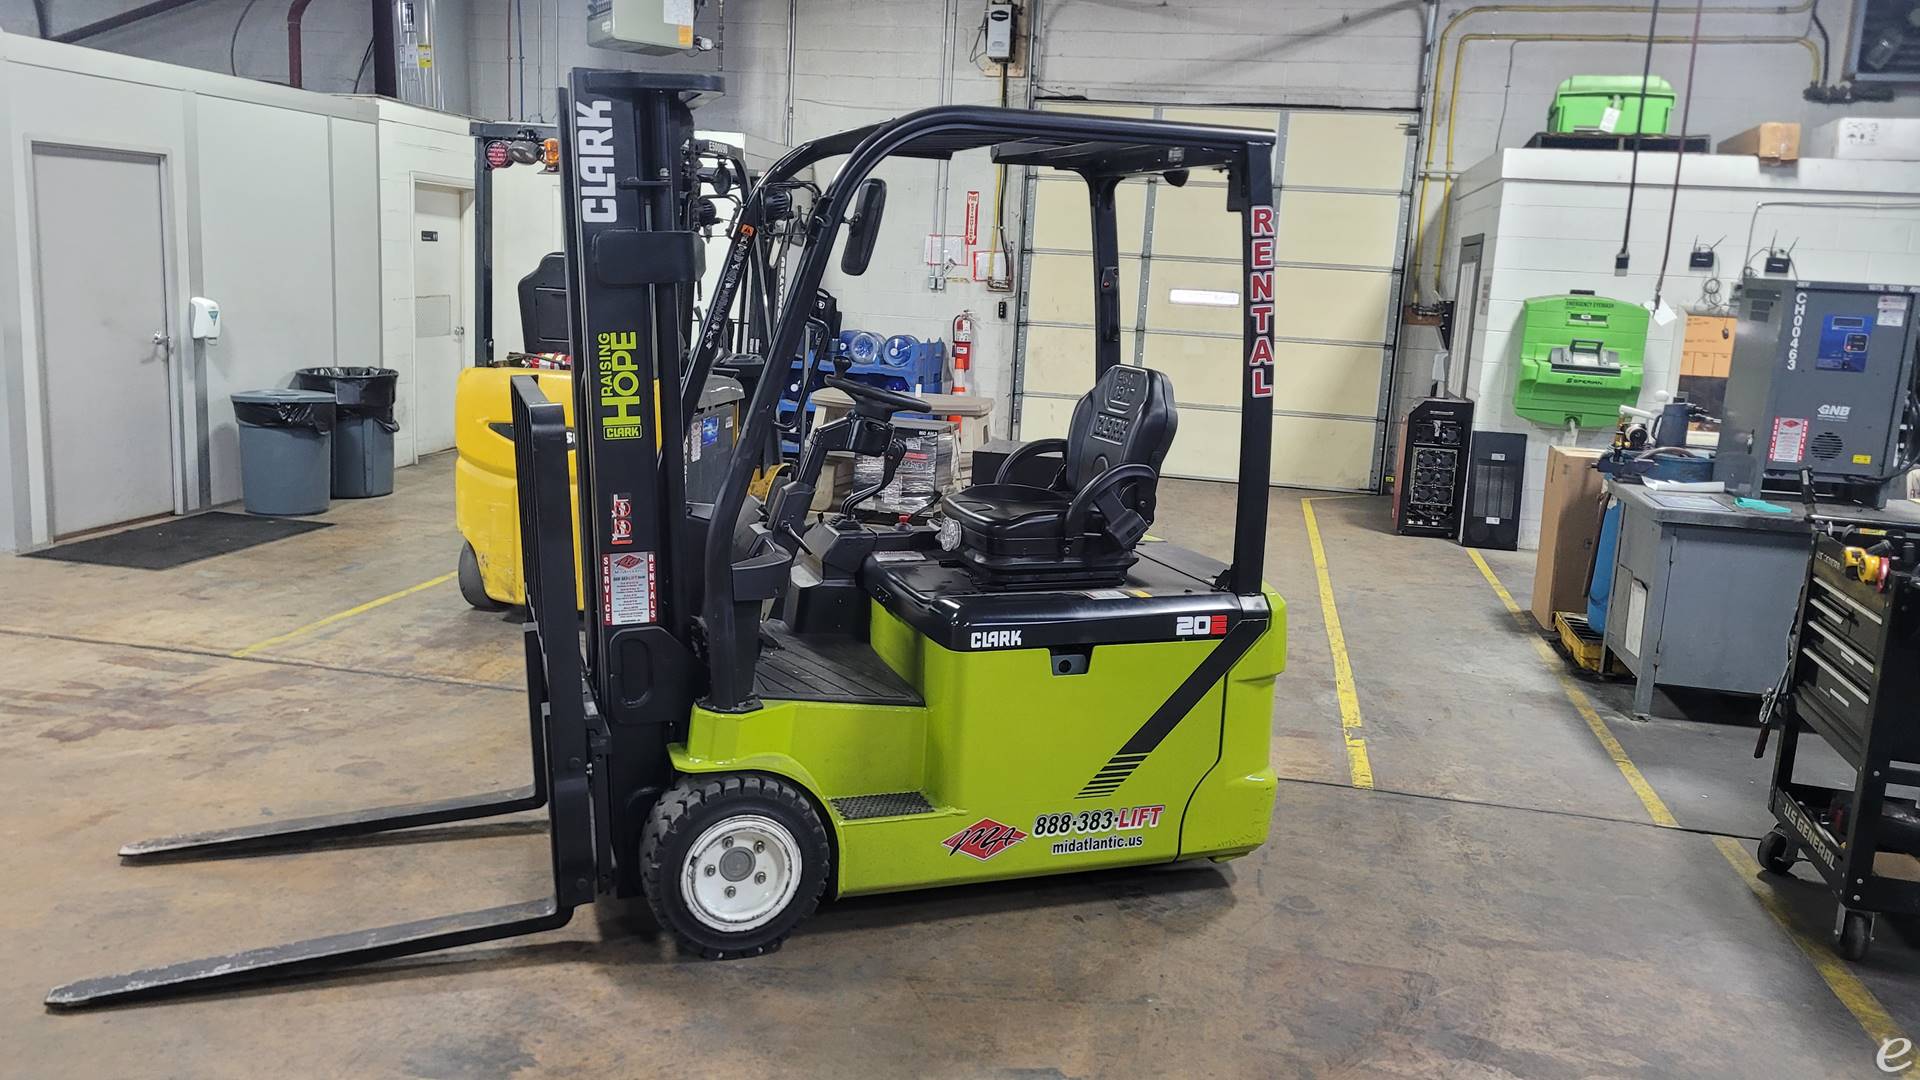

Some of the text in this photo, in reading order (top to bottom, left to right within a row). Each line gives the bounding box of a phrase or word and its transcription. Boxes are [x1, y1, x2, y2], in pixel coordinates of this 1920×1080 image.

[576, 100, 617, 223] CLARK
[1251, 206, 1274, 397] RENTAL
[1787, 292, 1808, 370] CH00463
[598, 332, 613, 397] RAISING
[602, 332, 641, 426] HOPE
[606, 427, 639, 438] CLARK
[1817, 404, 1851, 416] GNB
[603, 557, 611, 622] SERVICE
[648, 554, 656, 618] RENTALS
[971, 630, 1022, 649] CLARK
[1176, 615, 1227, 636] 20E
[1052, 835, 1143, 854] midatlantic.us
[1783, 803, 1836, 871] US GENERAL
